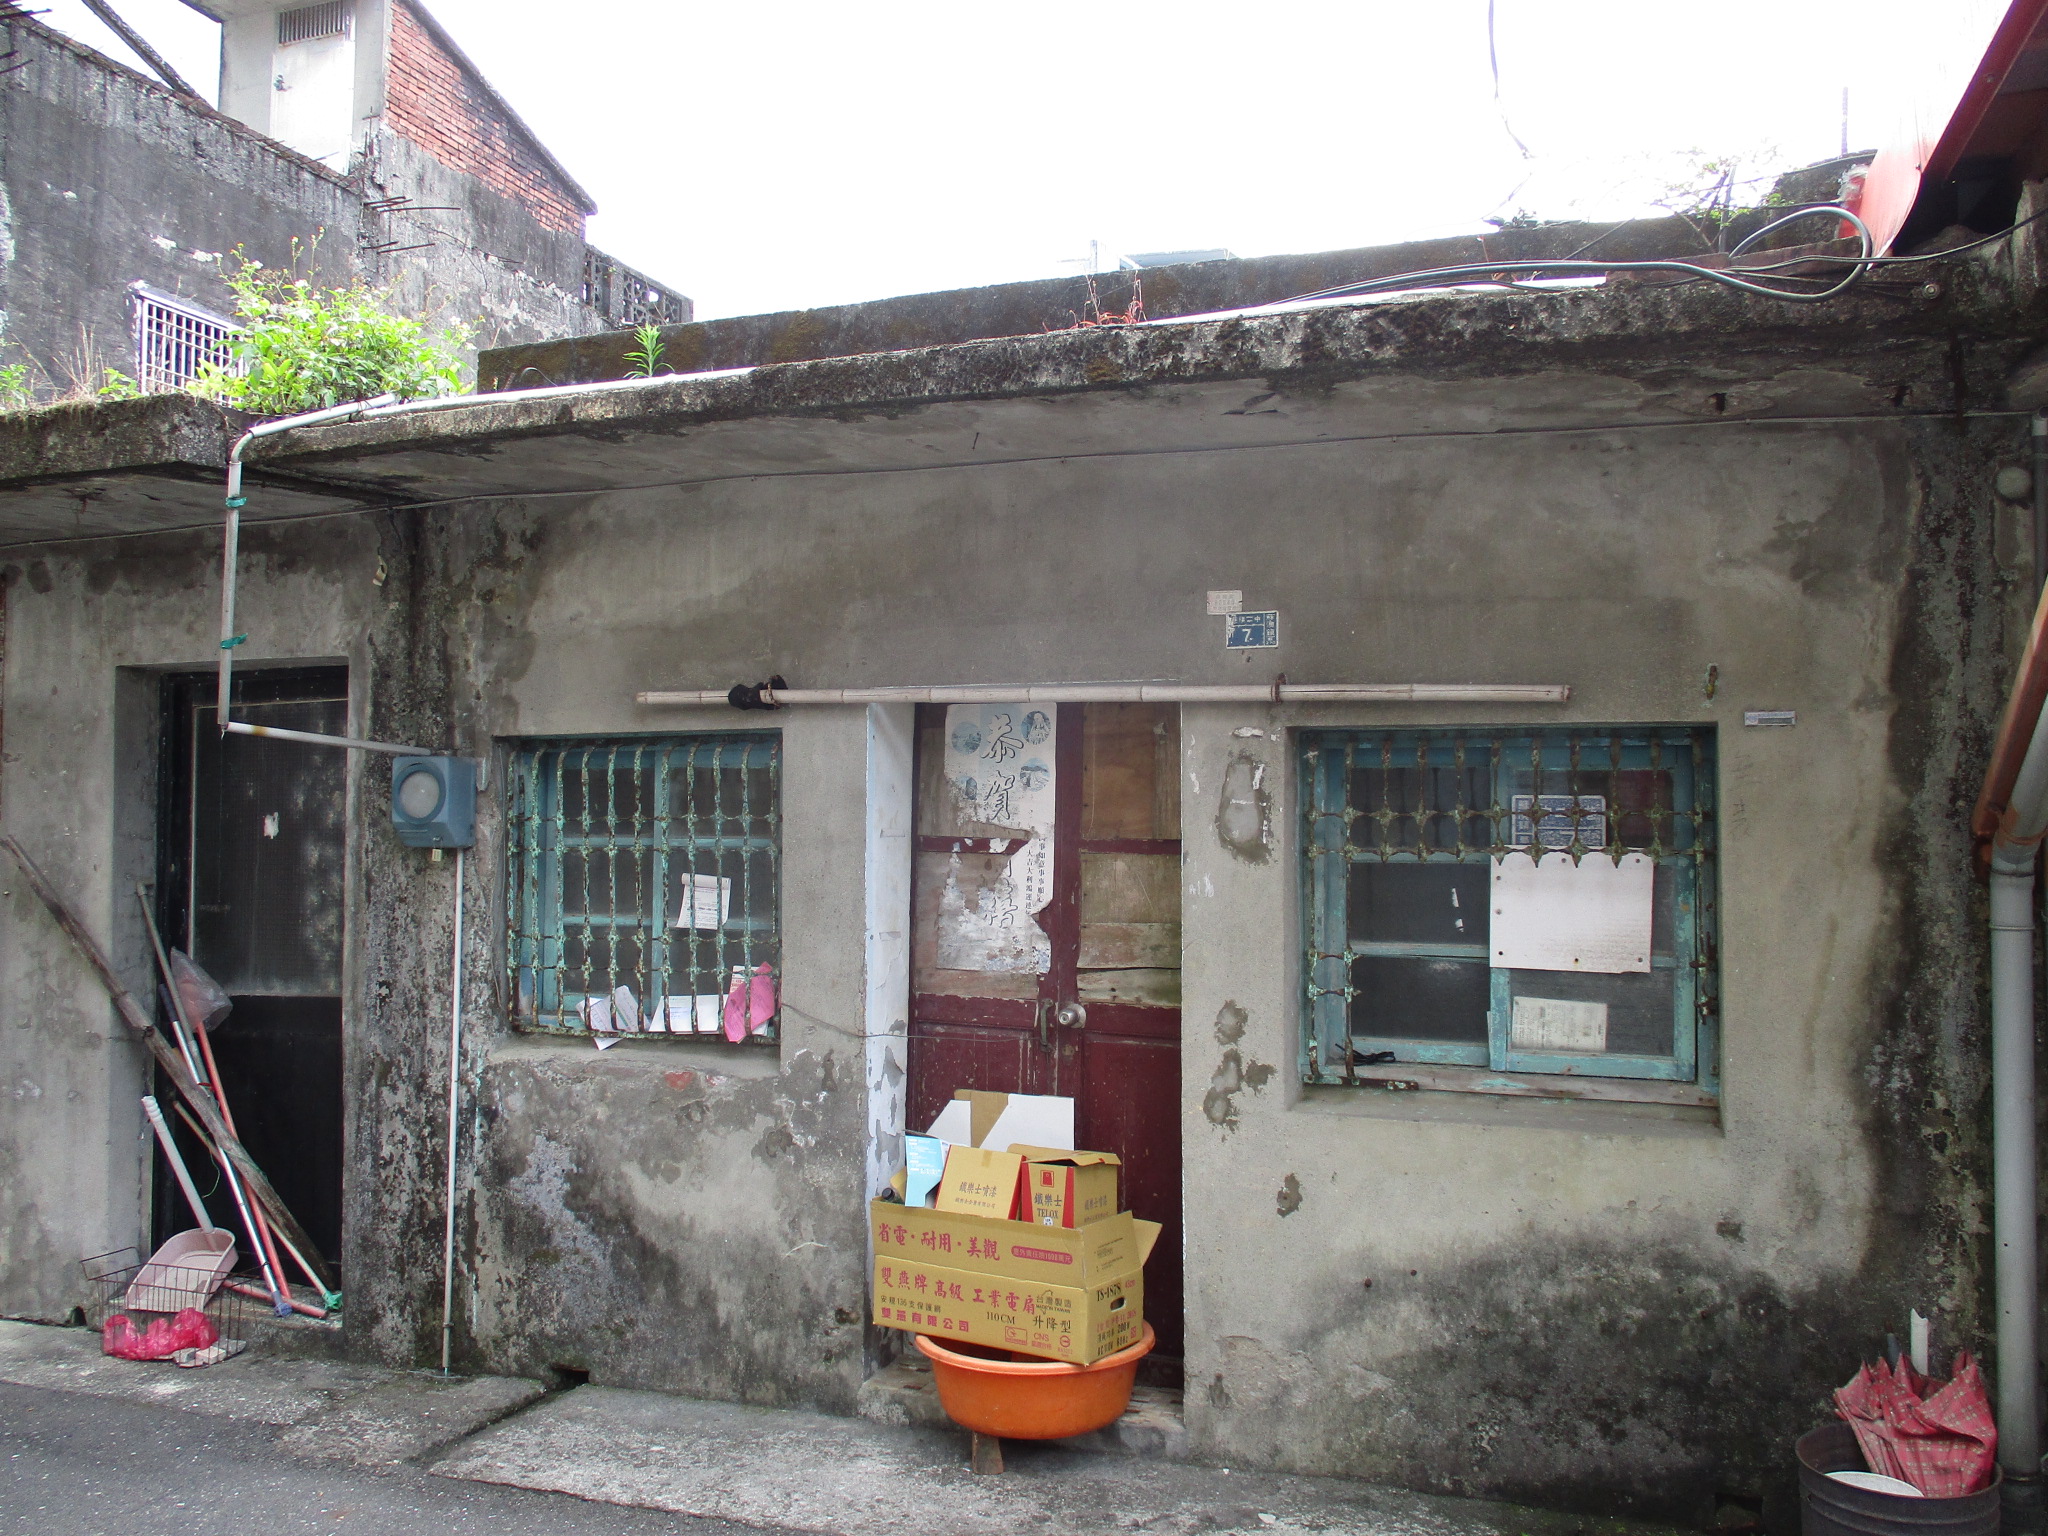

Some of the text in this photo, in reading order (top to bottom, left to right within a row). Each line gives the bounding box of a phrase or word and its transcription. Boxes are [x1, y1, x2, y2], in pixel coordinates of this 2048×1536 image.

[1242, 629, 1251, 642] 7
[1033, 1315, 1072, 1334] 升降型
